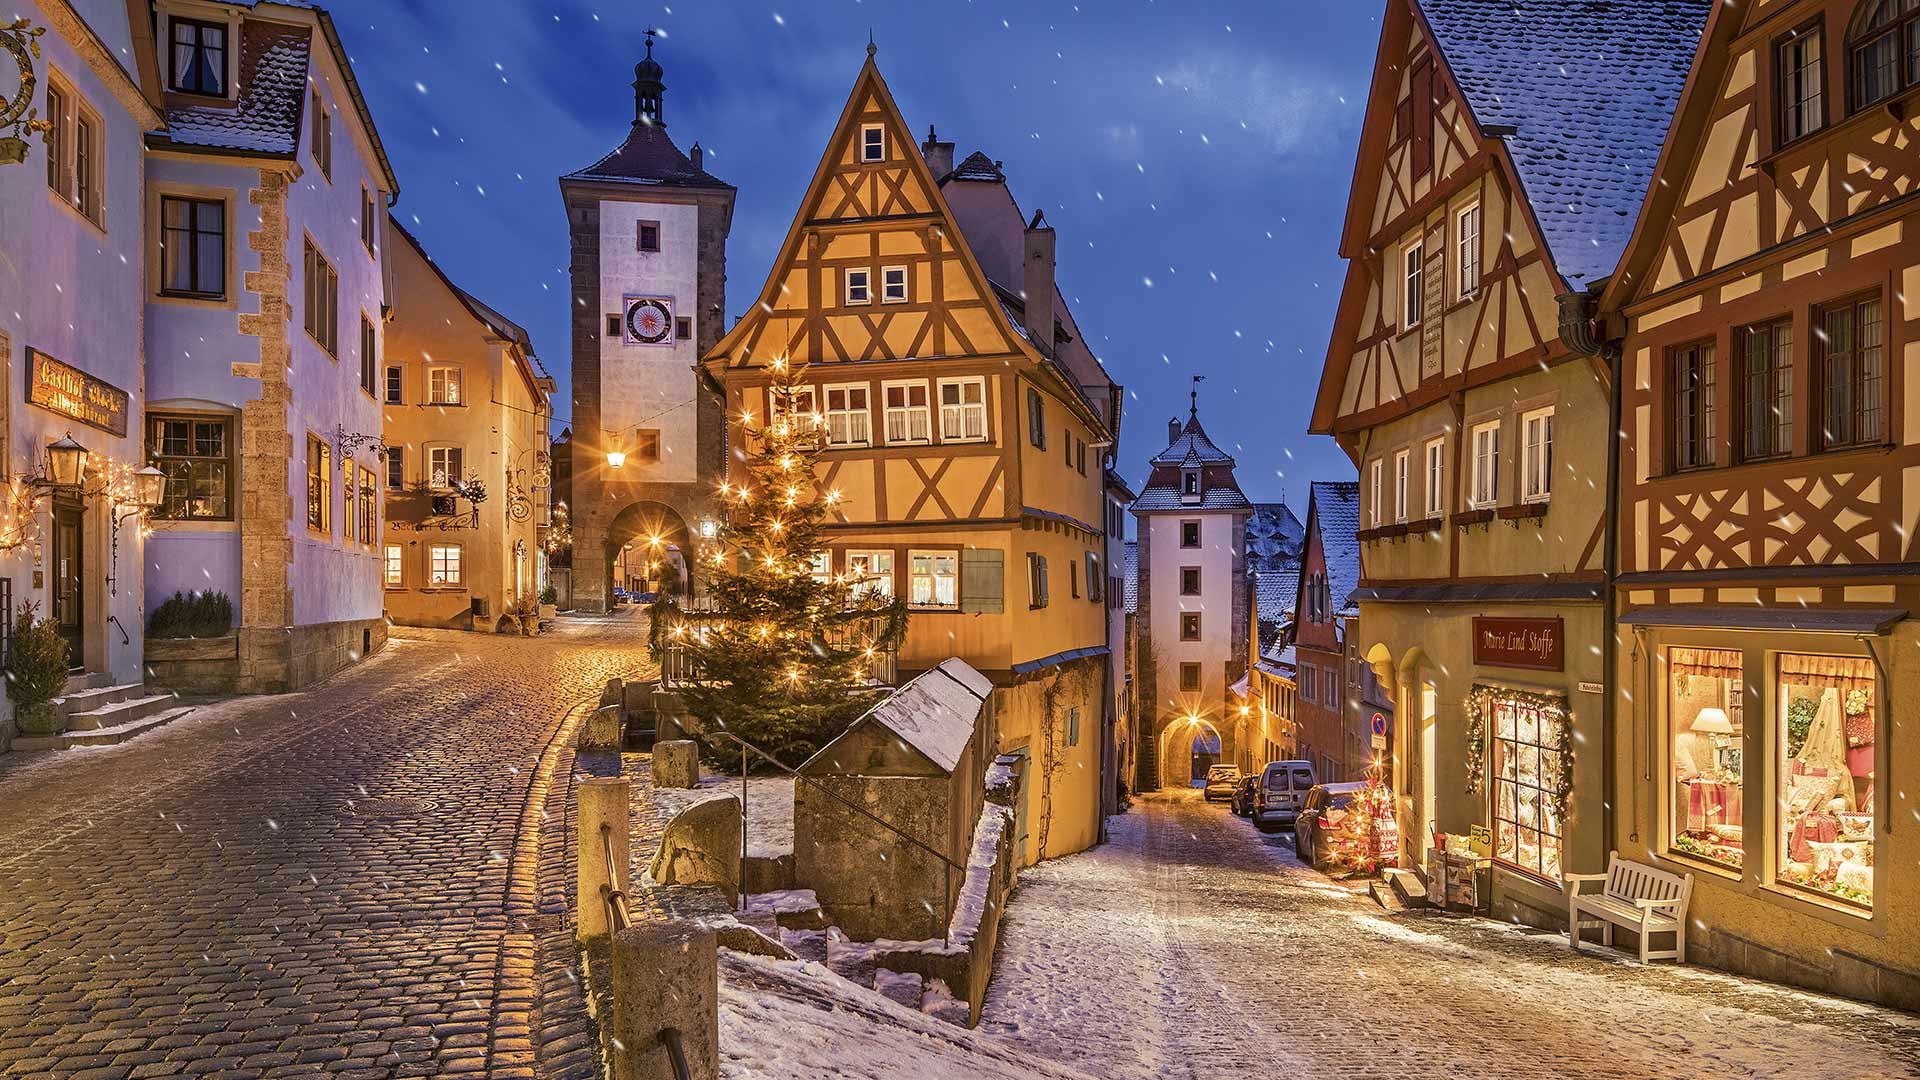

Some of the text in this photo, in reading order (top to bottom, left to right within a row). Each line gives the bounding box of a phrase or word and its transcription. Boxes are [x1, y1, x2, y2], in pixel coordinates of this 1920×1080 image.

[41, 361, 85, 398] Gasthof
[1483, 629, 1554, 659] Marie Lind Stoffe
[1482, 829, 1491, 845] 5
